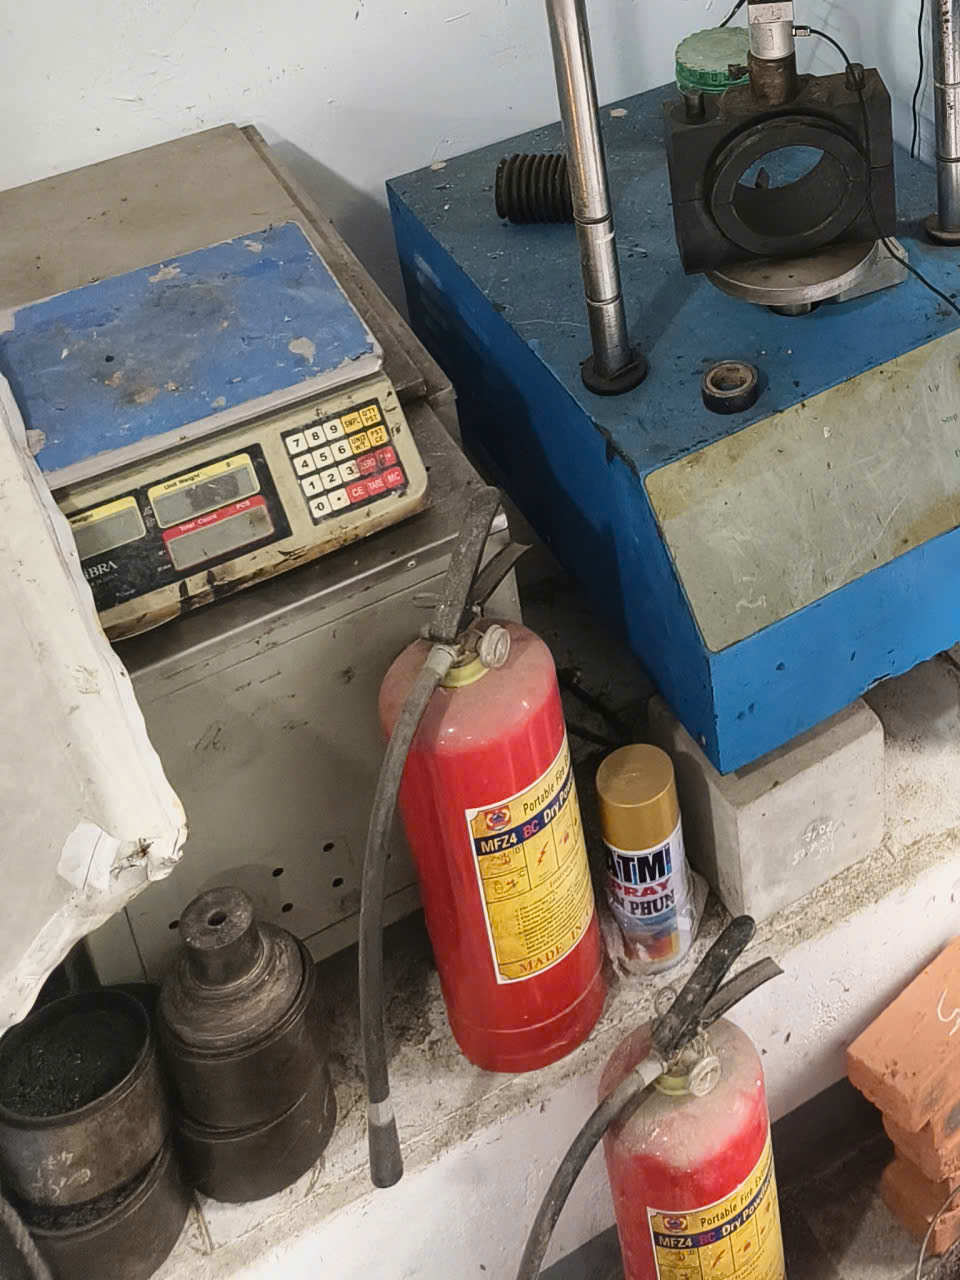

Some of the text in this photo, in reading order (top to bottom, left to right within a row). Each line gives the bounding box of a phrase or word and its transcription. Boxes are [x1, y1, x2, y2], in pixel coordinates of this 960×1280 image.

[292, 438, 300, 448] 7
[311, 431, 320, 441] 8
[329, 424, 338, 434] 9
[301, 459, 309, 469] 4
[319, 452, 328, 462] 5
[337, 445, 346, 455] 6
[308, 480, 316, 491] 1
[327, 473, 336, 483] 2
[345, 466, 354, 476] 3
[351, 486, 365, 497] CE
[367, 479, 385, 491] TARE
[387, 470, 401, 482] MC
[80, 559, 119, 581] iBRA
[522, 782, 555, 816] Portable
[480, 832, 518, 854] MFZ4
[522, 819, 541, 839] BC
[542, 803, 560, 824] Dry
[608, 876, 671, 898] PRAY
[519, 924, 583, 973] MADE IN
[700, 1187, 754, 1228] Portable Fire
[658, 1235, 693, 1248] MFZ4
[721, 1219, 741, 1237] Dry
